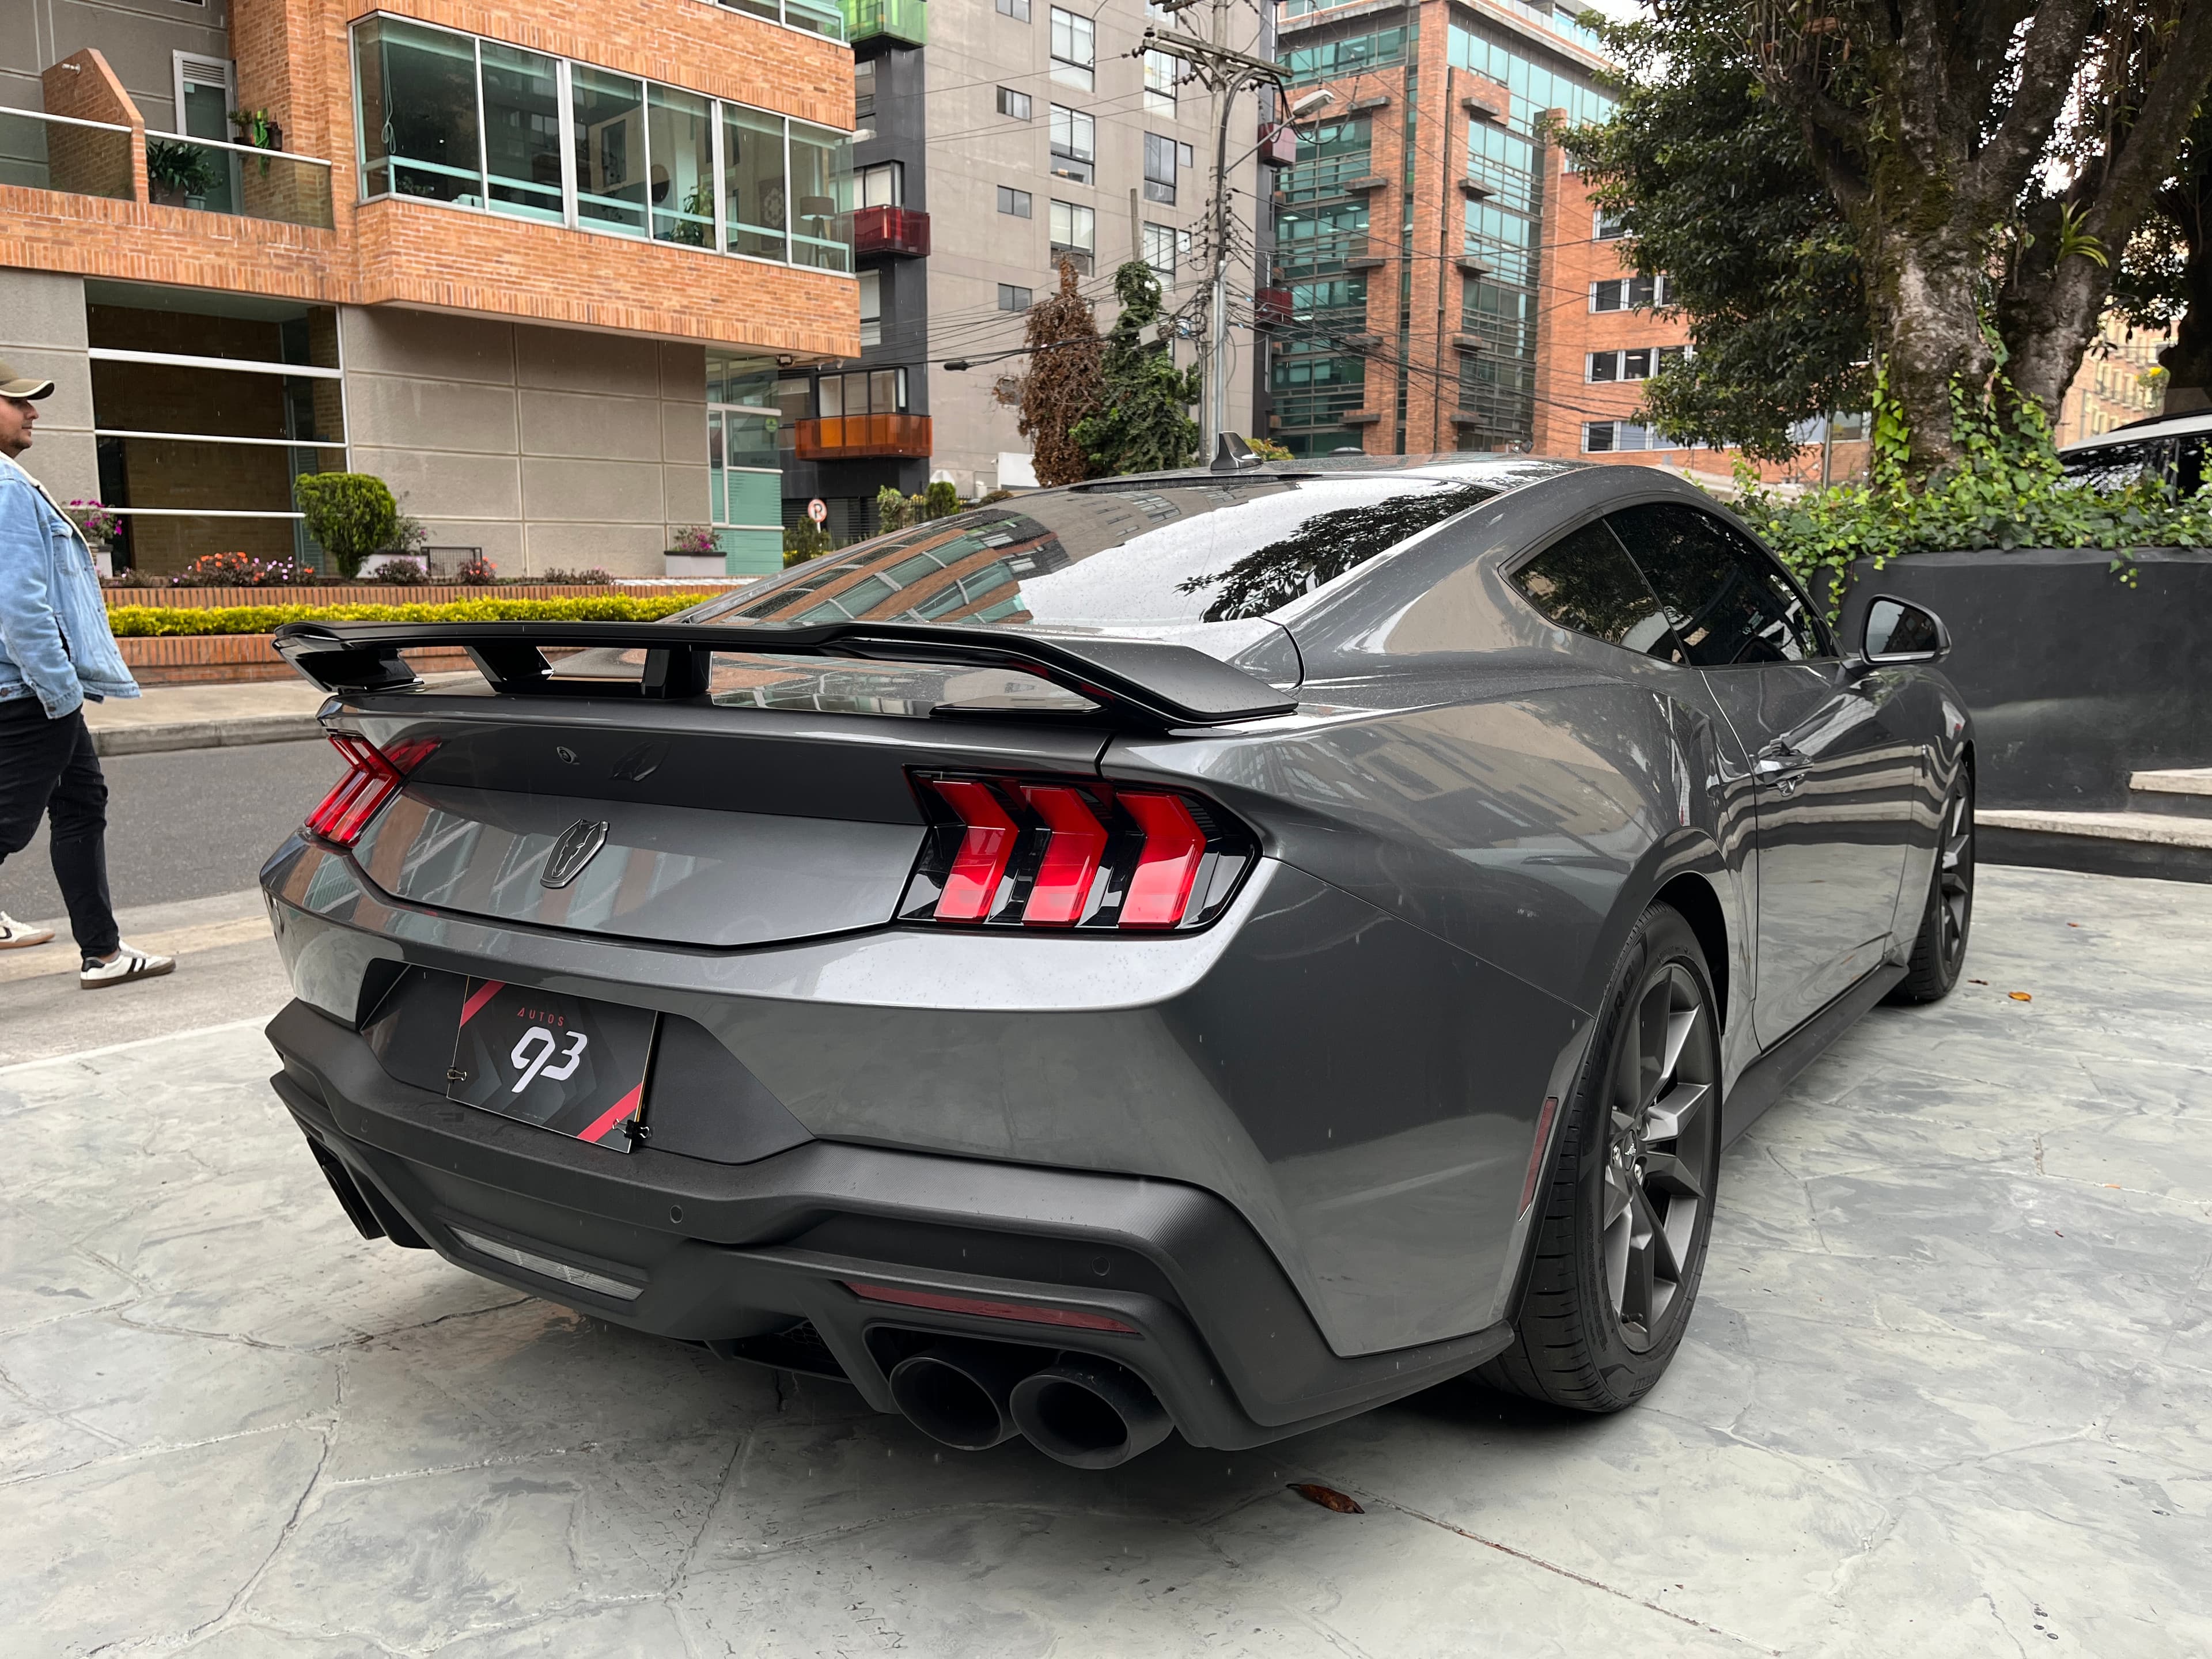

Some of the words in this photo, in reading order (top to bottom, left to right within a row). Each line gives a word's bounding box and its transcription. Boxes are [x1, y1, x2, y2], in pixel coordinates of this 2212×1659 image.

[813, 503, 823, 518] P
[517, 1007, 565, 1027] AUTOS
[510, 1026, 588, 1093] 93
